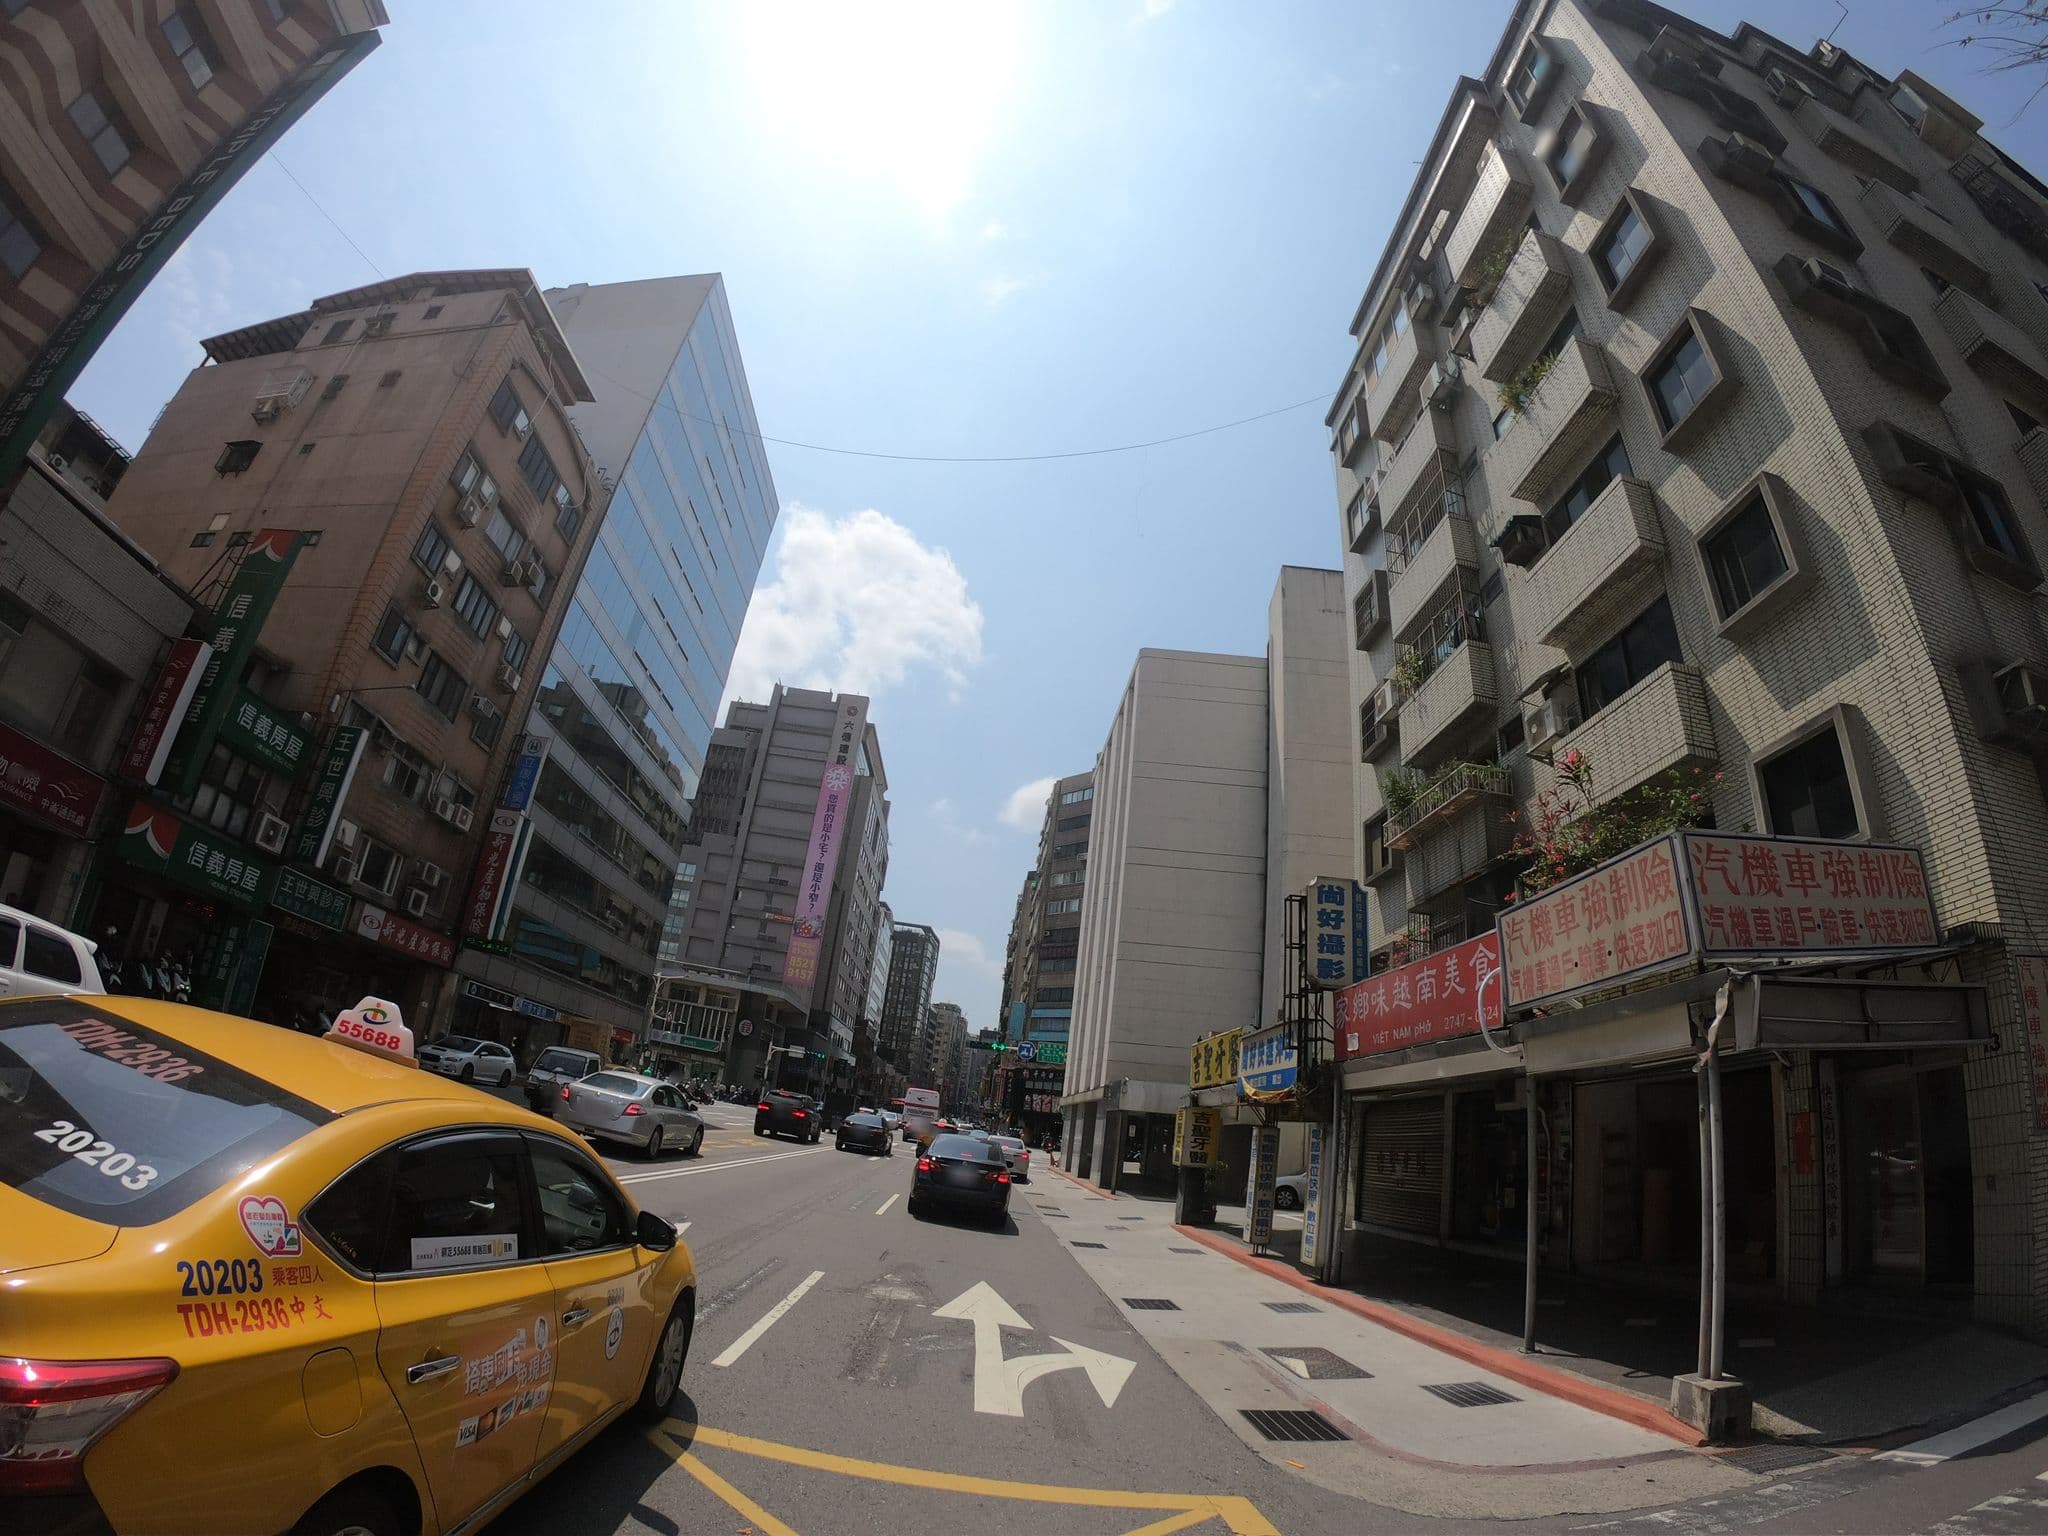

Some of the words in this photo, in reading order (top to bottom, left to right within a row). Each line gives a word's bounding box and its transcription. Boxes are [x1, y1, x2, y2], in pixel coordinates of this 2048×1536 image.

[192, 102, 287, 186] TRIPLE
[116, 194, 194, 272] BEDS
[237, 702, 304, 761] 信義房屋
[297, 733, 354, 857] 王世興診所
[186, 841, 261, 892] 信義房屋
[280, 874, 346, 914] 王世興診所
[469, 833, 507, 934] 新光產物保險
[1692, 842, 1925, 900] 汽機車強制險
[1317, 885, 1345, 979] 尚好攝影
[1505, 848, 1675, 961] 汽機車強制險
[382, 920, 452, 962] 新光產物保險
[1335, 942, 1497, 1028] 家鄉味越南美食
[58, 1018, 204, 1082] TDH-2936
[338, 1020, 401, 1050] 55688
[1193, 1034, 1239, 1084] 吉聖牙醫
[1393, 1026, 1411, 1040] NAM
[33, 1120, 158, 1191] 20203
[1190, 1112, 1213, 1164] 吉聖牙醫
[177, 1259, 264, 1296] 20203
[272, 1265, 325, 1286] 乘客四人
[177, 1297, 290, 1338] TDH-2936
[460, 1424, 476, 1440] VISA
